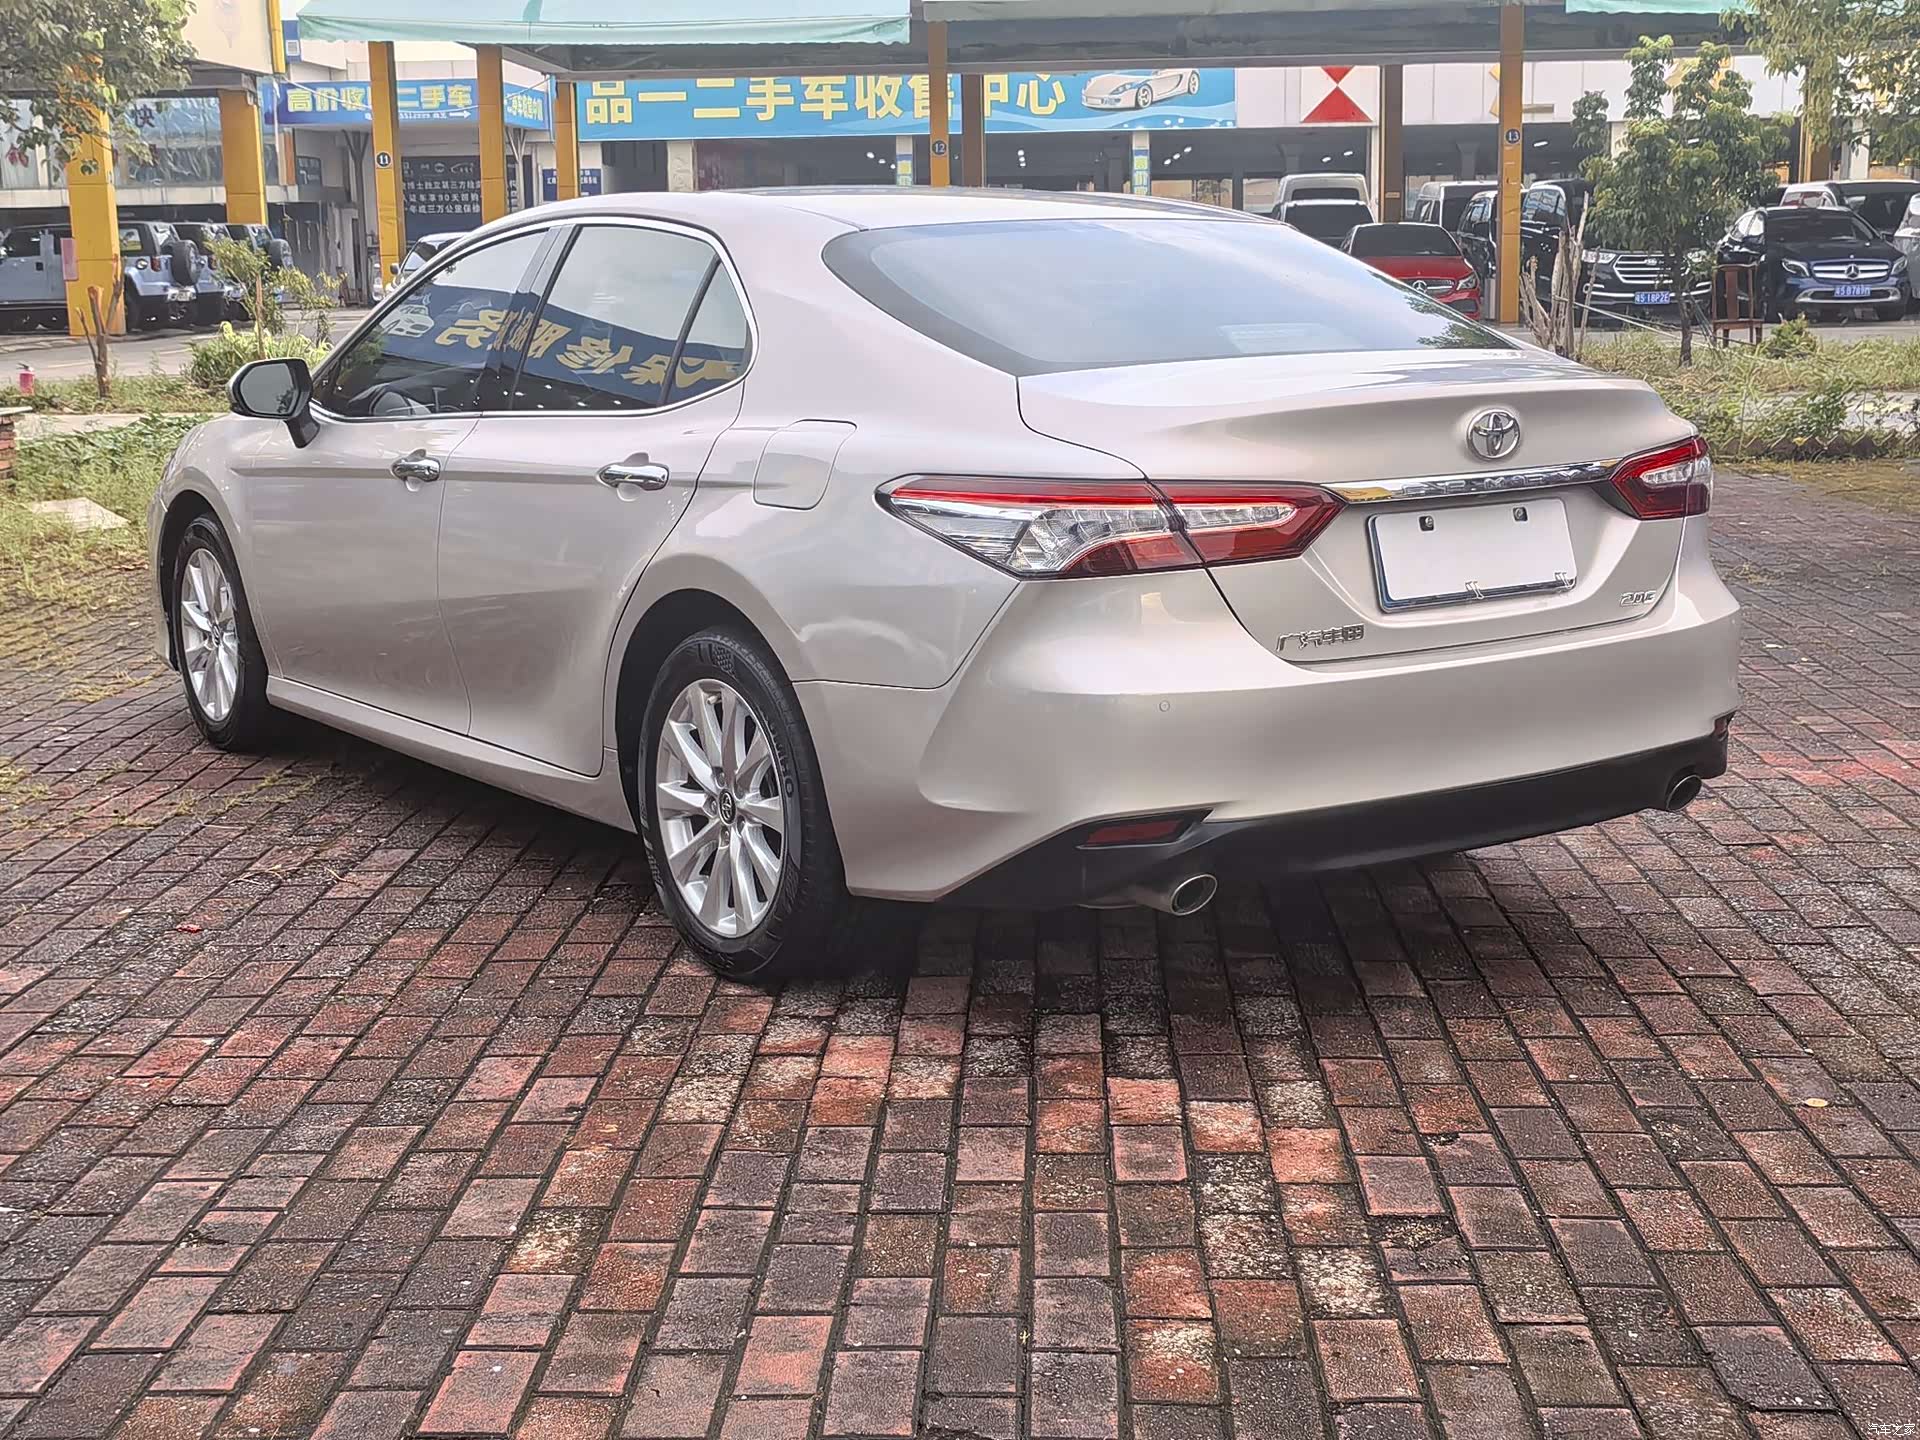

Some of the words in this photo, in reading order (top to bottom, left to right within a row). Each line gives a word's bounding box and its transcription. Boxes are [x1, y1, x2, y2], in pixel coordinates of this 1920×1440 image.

[286, 85, 473, 112] 高价收二手车
